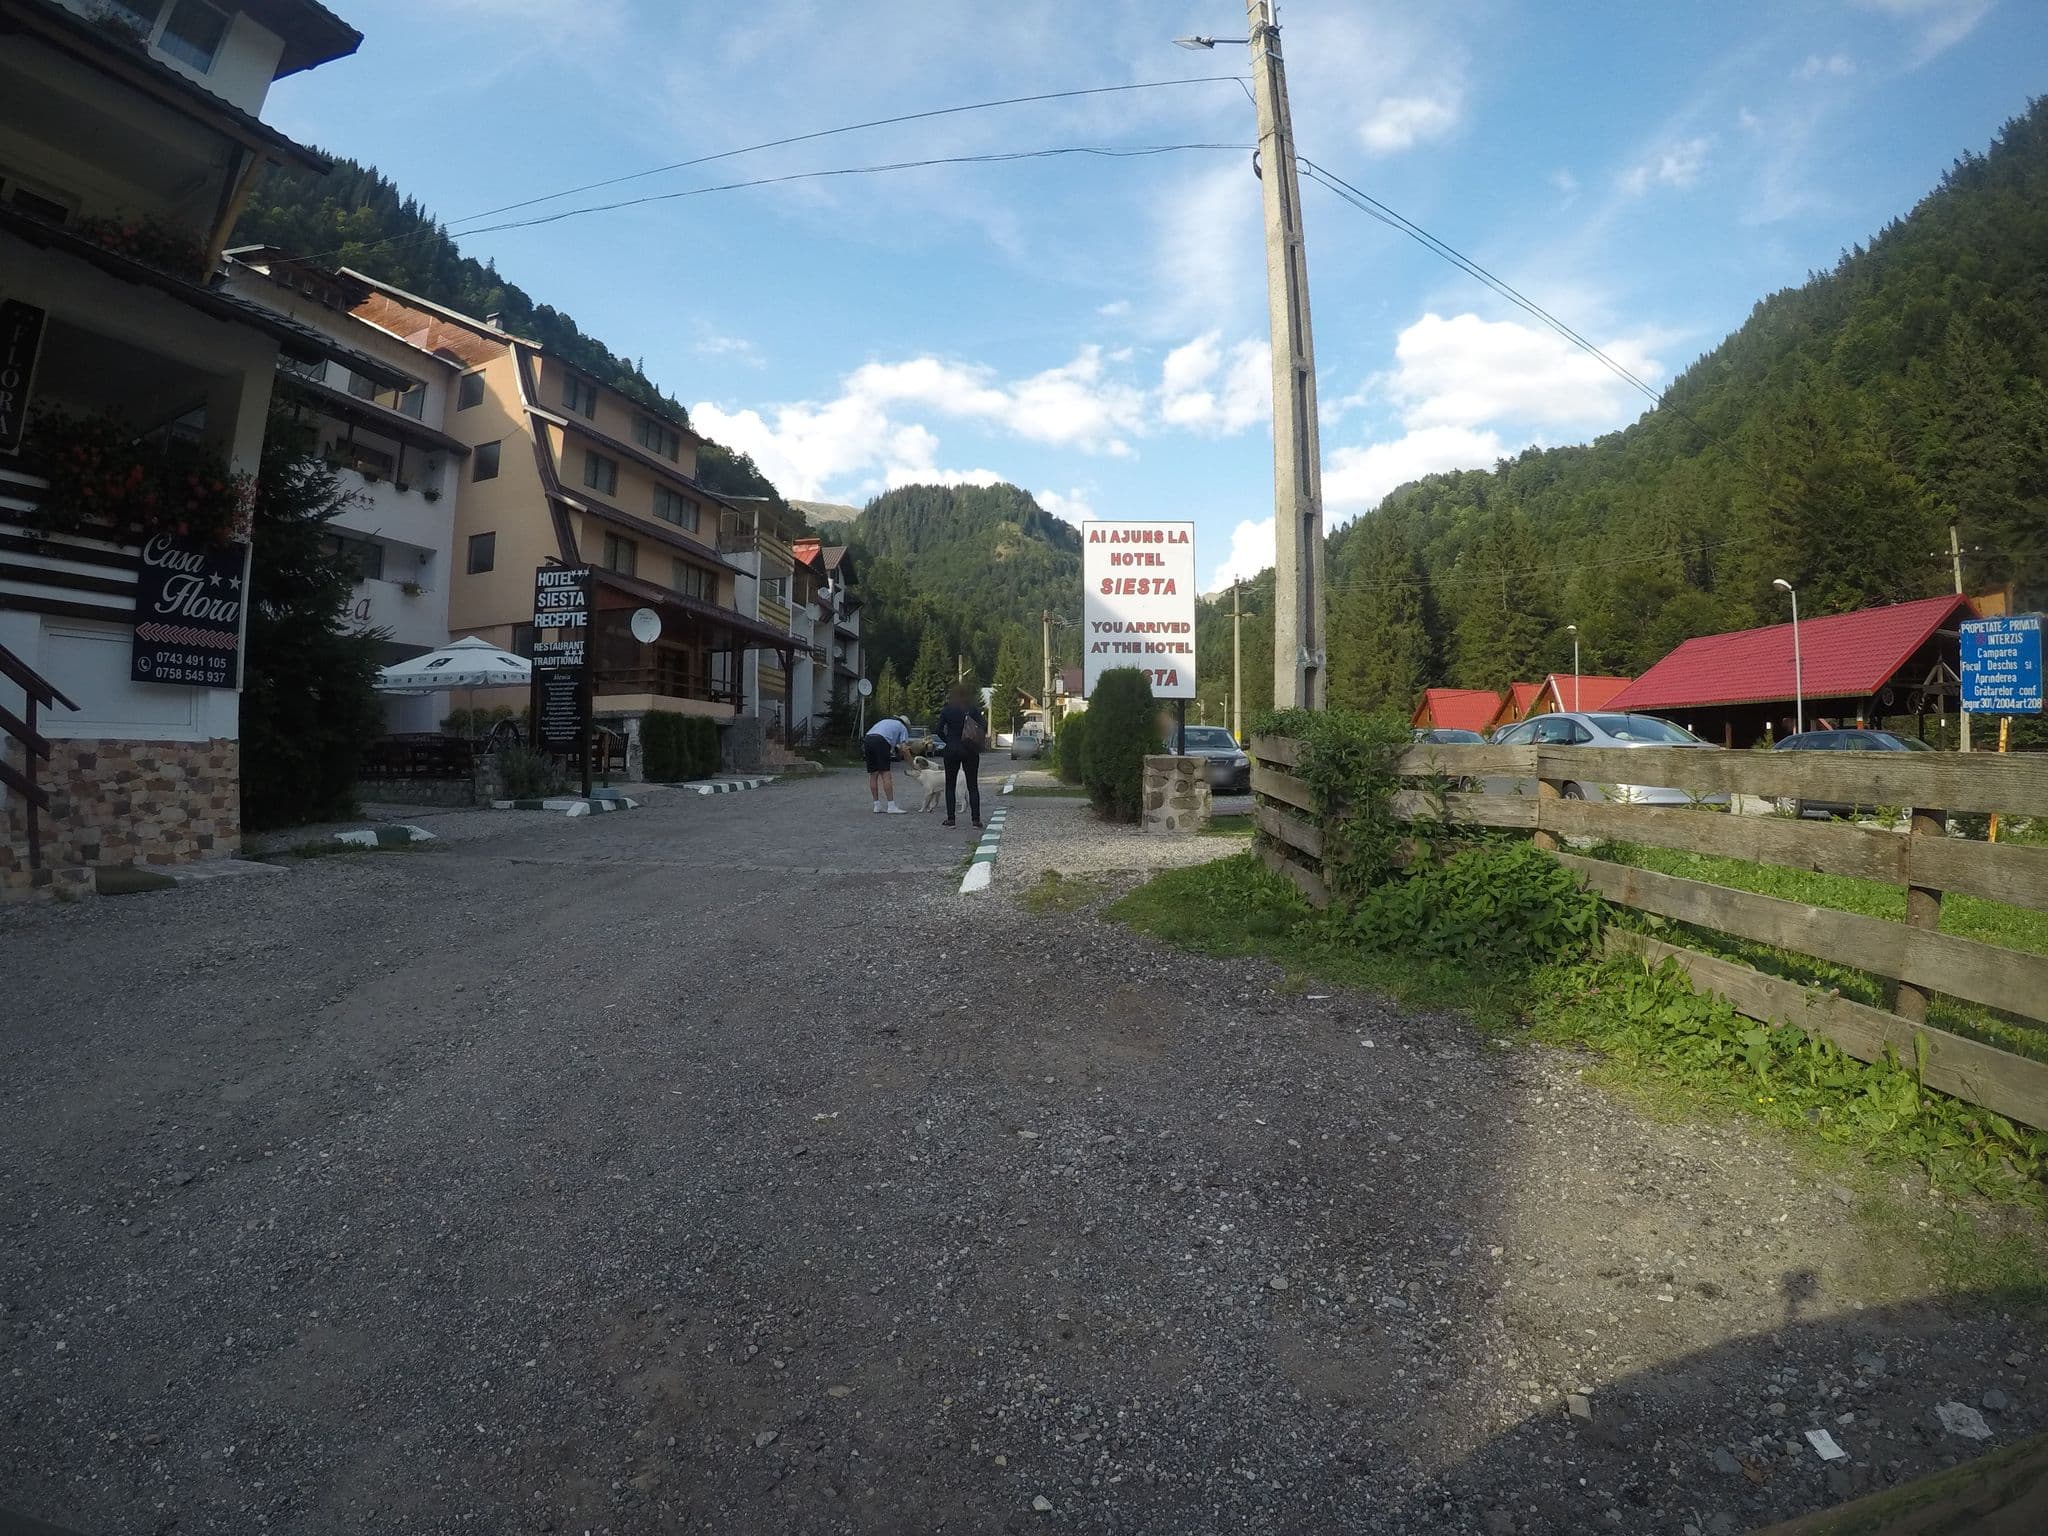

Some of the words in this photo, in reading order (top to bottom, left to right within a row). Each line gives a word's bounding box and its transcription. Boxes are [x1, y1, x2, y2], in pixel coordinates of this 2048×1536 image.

[1089, 530, 1106, 543] AI
[1110, 530, 1164, 543] AJUNS
[1168, 530, 1190, 543] LA
[143, 533, 206, 573] Casa
[1110, 553, 1166, 566] HOTEL
[537, 571, 575, 587] HOTEL
[1100, 578, 1177, 595] SIESTA
[154, 574, 239, 623] Flora
[537, 591, 585, 608] SIESTA
[1091, 621, 1123, 633] YOU
[1125, 621, 1191, 633] ARRIVED
[1987, 633, 2024, 645] INTERZIS
[533, 640, 585, 652] RESTAURANT
[1090, 642, 1110, 654] AT
[1112, 642, 1142, 654] THE
[1144, 642, 1193, 654] HOTEL
[156, 651, 183, 665] 0743
[185, 654, 204, 666] 491
[208, 657, 227, 669] 105
[1977, 647, 2018, 660] Camparea
[1962, 661, 1981, 671] Focul
[1987, 659, 2018, 670] Deschis
[155, 666, 182, 679] 0758
[185, 669, 204, 681] 545
[207, 671, 226, 683] 937
[1975, 672, 2017, 685] Aprinderea
